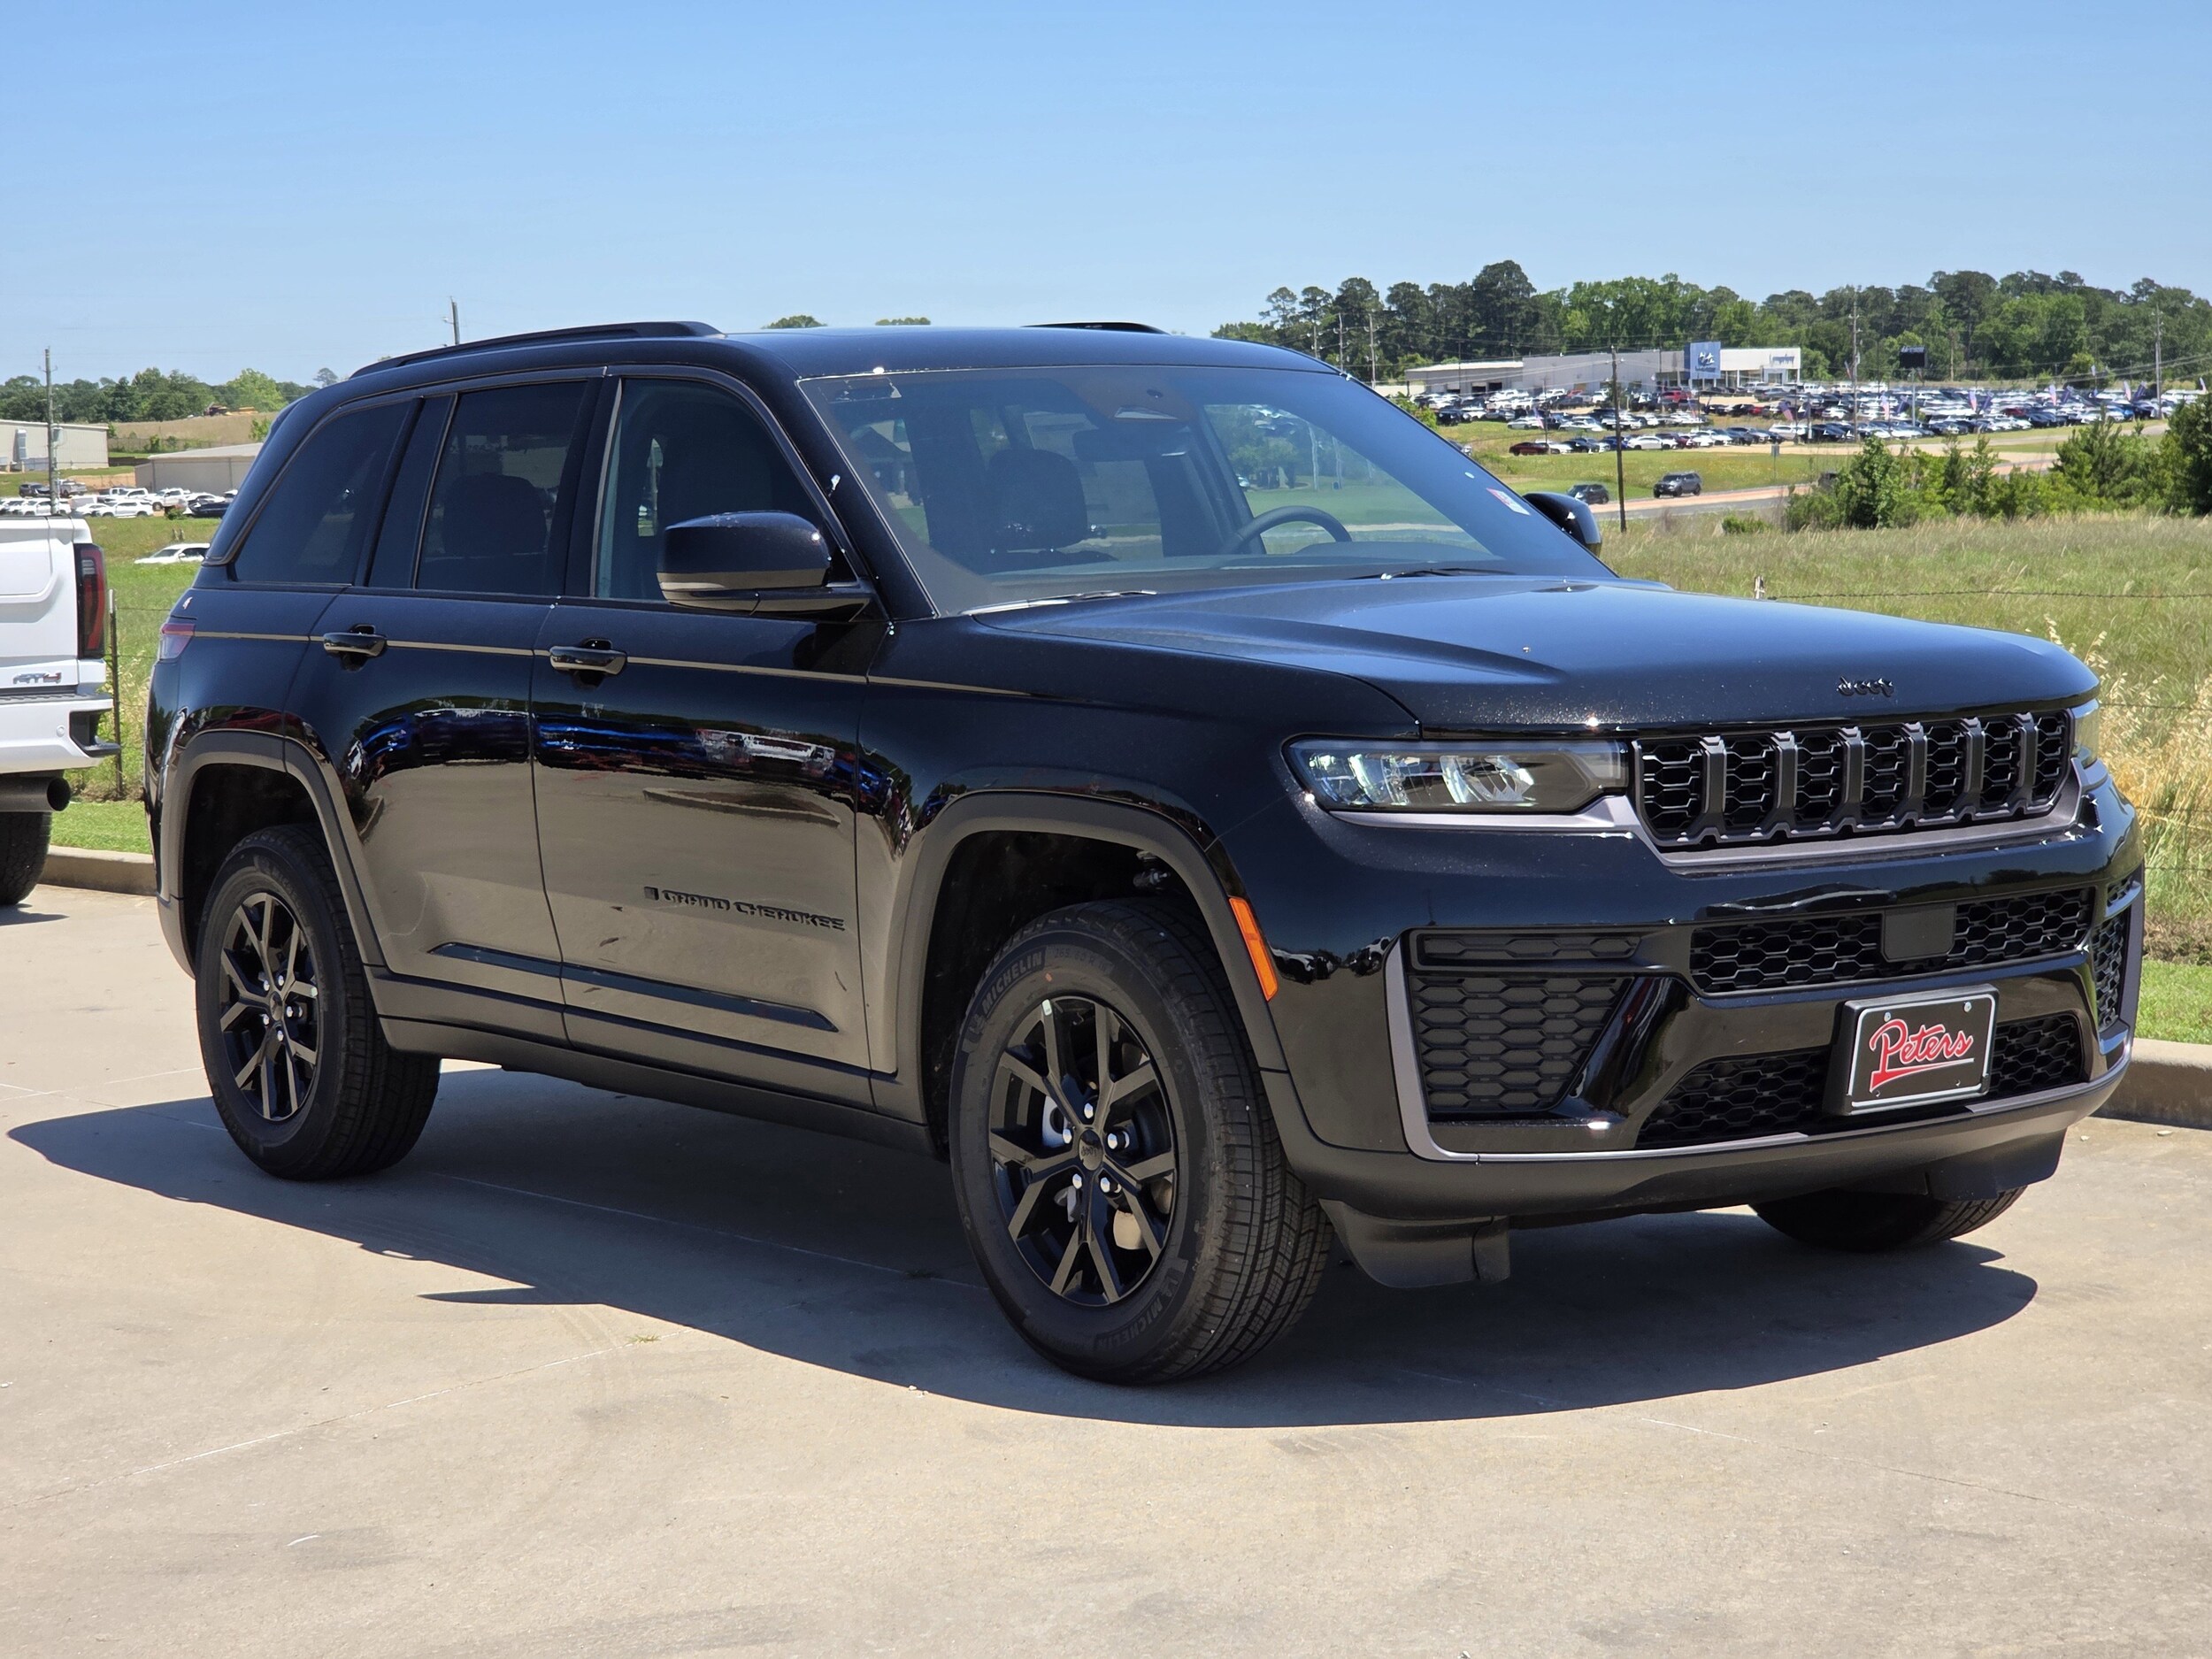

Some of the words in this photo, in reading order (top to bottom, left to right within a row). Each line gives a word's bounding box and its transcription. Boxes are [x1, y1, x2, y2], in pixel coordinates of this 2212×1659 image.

[662, 889, 730, 910] GRAND
[733, 901, 846, 932] CHEROKEE
[980, 951, 1043, 1015] MICHELIN
[1869, 1018, 1973, 1083] Peters
